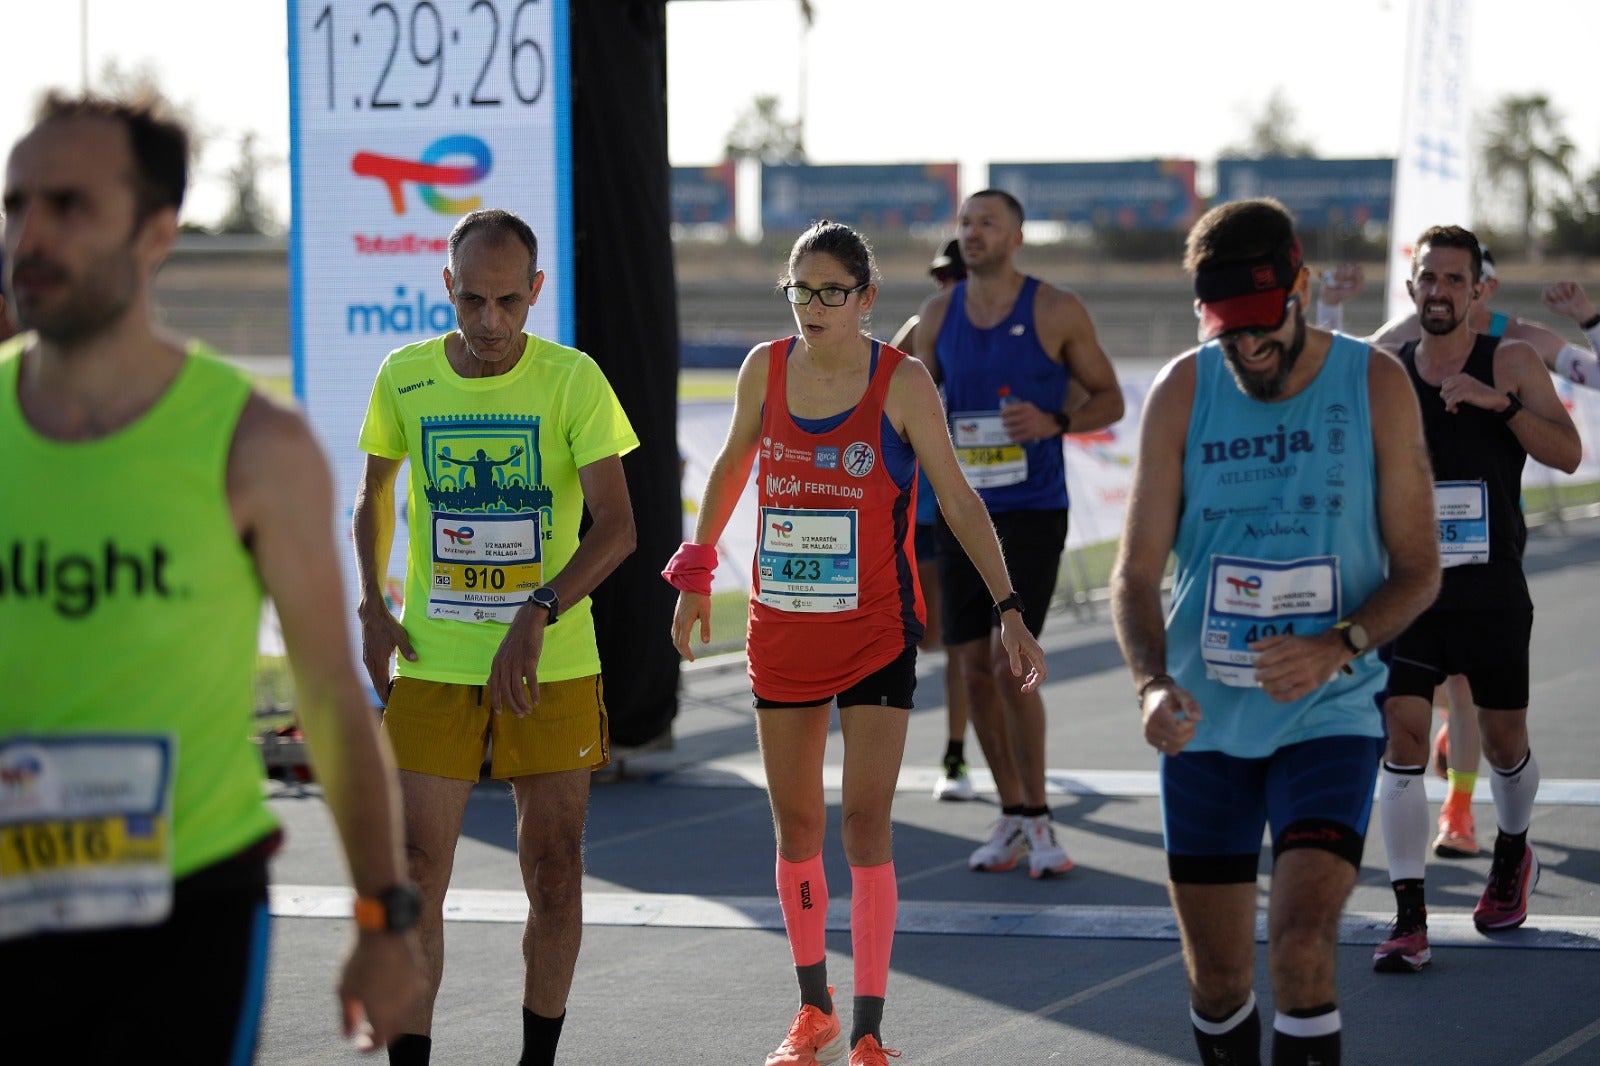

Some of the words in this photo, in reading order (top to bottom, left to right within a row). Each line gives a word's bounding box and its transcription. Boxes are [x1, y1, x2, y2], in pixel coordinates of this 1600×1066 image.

[312, 0, 546, 111] 1:29:26
[398, 380, 425, 395] luanvi
[1201, 424, 1315, 465] nerja
[1216, 464, 1298, 486] ATLETISMO
[804, 482, 864, 499] FERTILIDAD
[464, 567, 505, 590] 910
[781, 559, 822, 581] 423
[464, 594, 506, 603] MARATHON
[787, 584, 815, 592] TERESA
[800, 880, 814, 911] Joma
